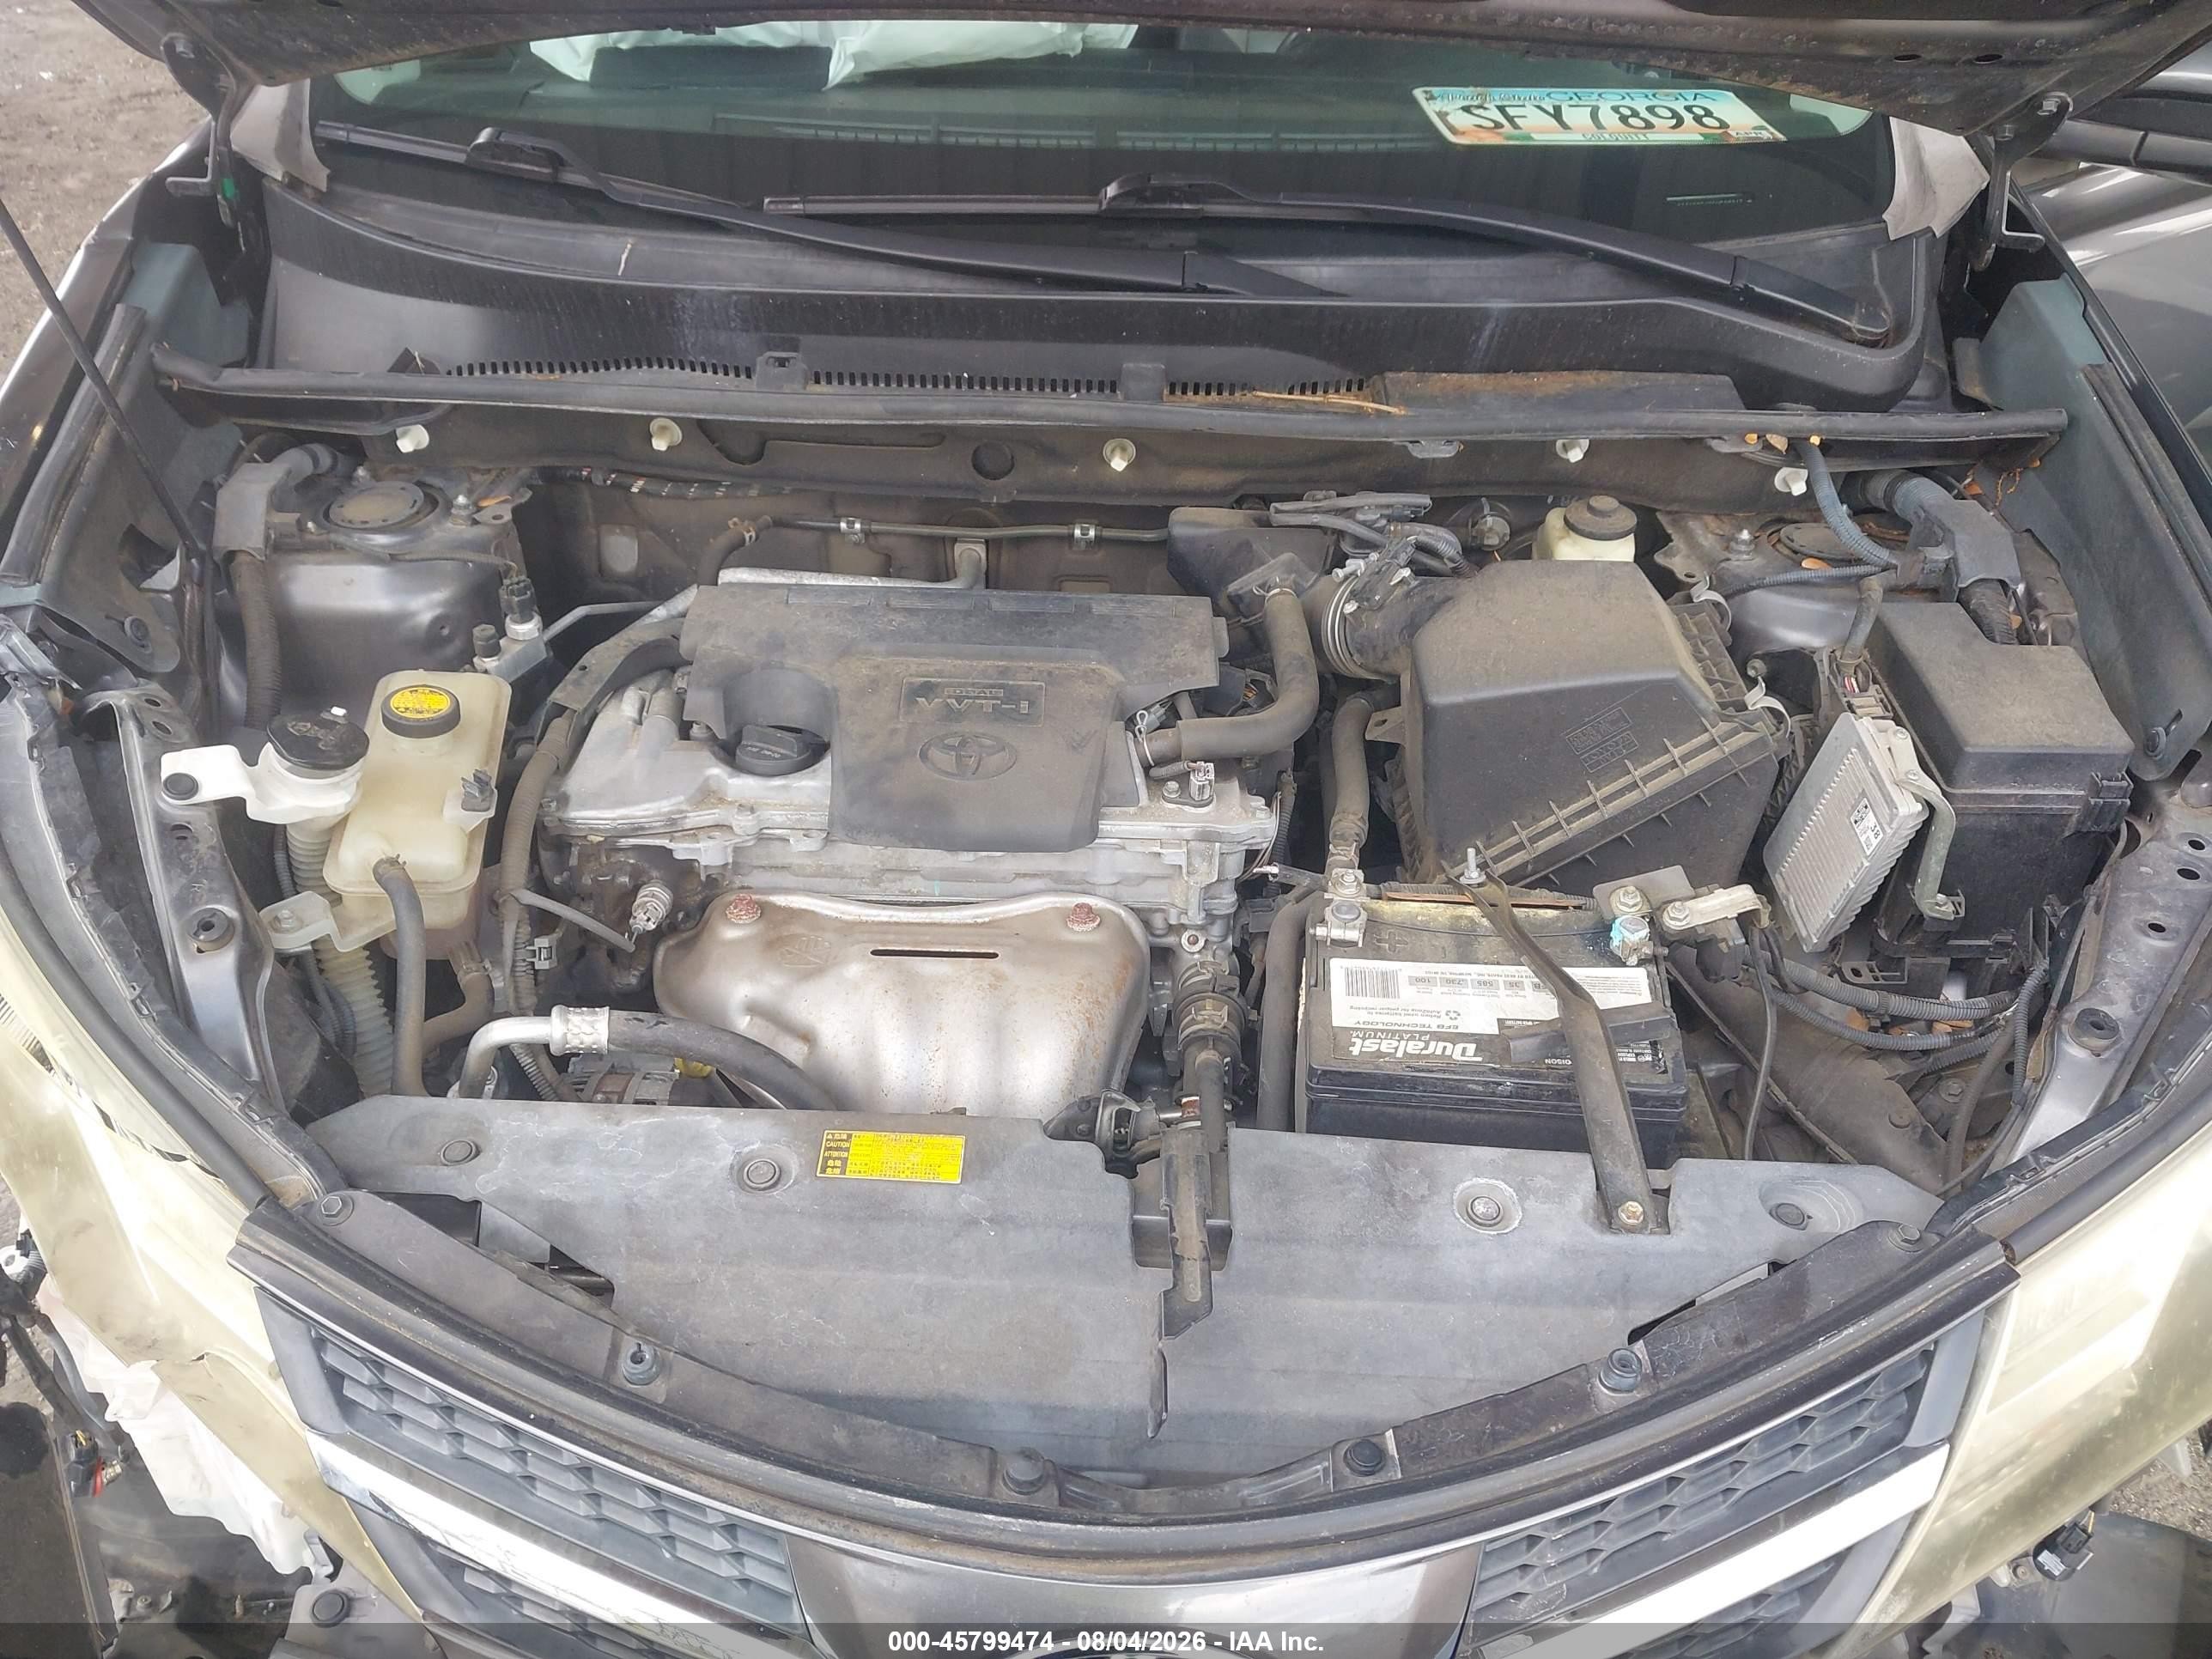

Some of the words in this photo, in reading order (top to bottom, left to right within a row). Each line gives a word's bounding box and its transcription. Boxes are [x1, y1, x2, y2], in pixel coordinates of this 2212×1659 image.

[1546, 91, 1718, 101] GEORGIA
[1456, 104, 1730, 131] SFY7898
[1869, 823, 1881, 840] 38
[1353, 1019, 1432, 1029] TECHNOLOGY
[1348, 1037, 1483, 1061] Duralast
